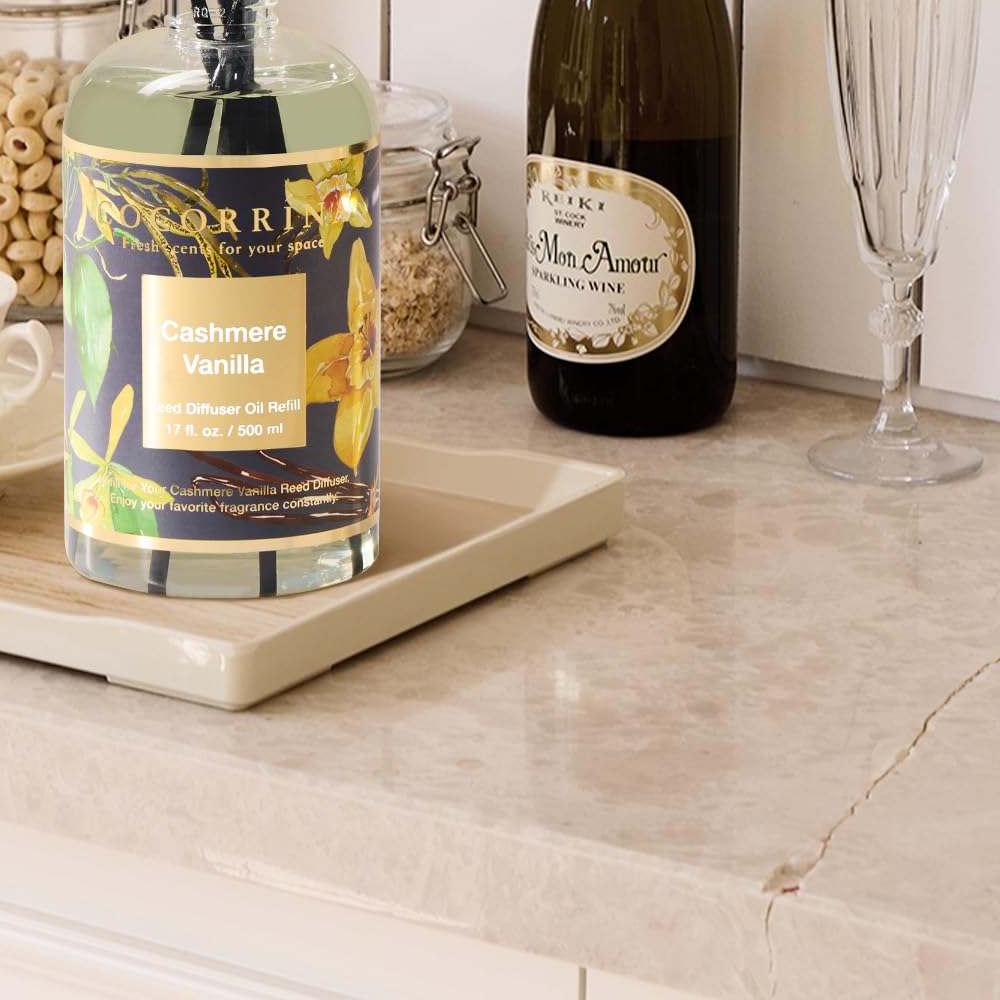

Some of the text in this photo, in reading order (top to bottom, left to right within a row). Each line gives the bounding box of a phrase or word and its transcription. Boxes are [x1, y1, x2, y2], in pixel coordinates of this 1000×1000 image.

[122, 236, 160, 253] Fresh
[219, 241, 243, 255] for
[248, 240, 283, 258] your
[287, 237, 325, 254] space
[535, 229, 577, 267] Mon
[580, 240, 667, 275] Amour
[531, 266, 625, 294] SPARKLING WINE
[161, 319, 288, 343] Cashmere
[183, 353, 265, 375] Vanilla
[151, 399, 301, 416] eed Diffuser Oil Refill
[167, 423, 284, 437] 17 fl. oz. / 500 ml
[141, 483, 167, 494] Your
[170, 484, 233, 497] Cashmere
[239, 485, 278, 496] Vanilla
[280, 480, 310, 494] Reed
[313, 474, 350, 490] Diffuser.
[110, 493, 339, 515] Enjoy your favorite fragrance constantly.
